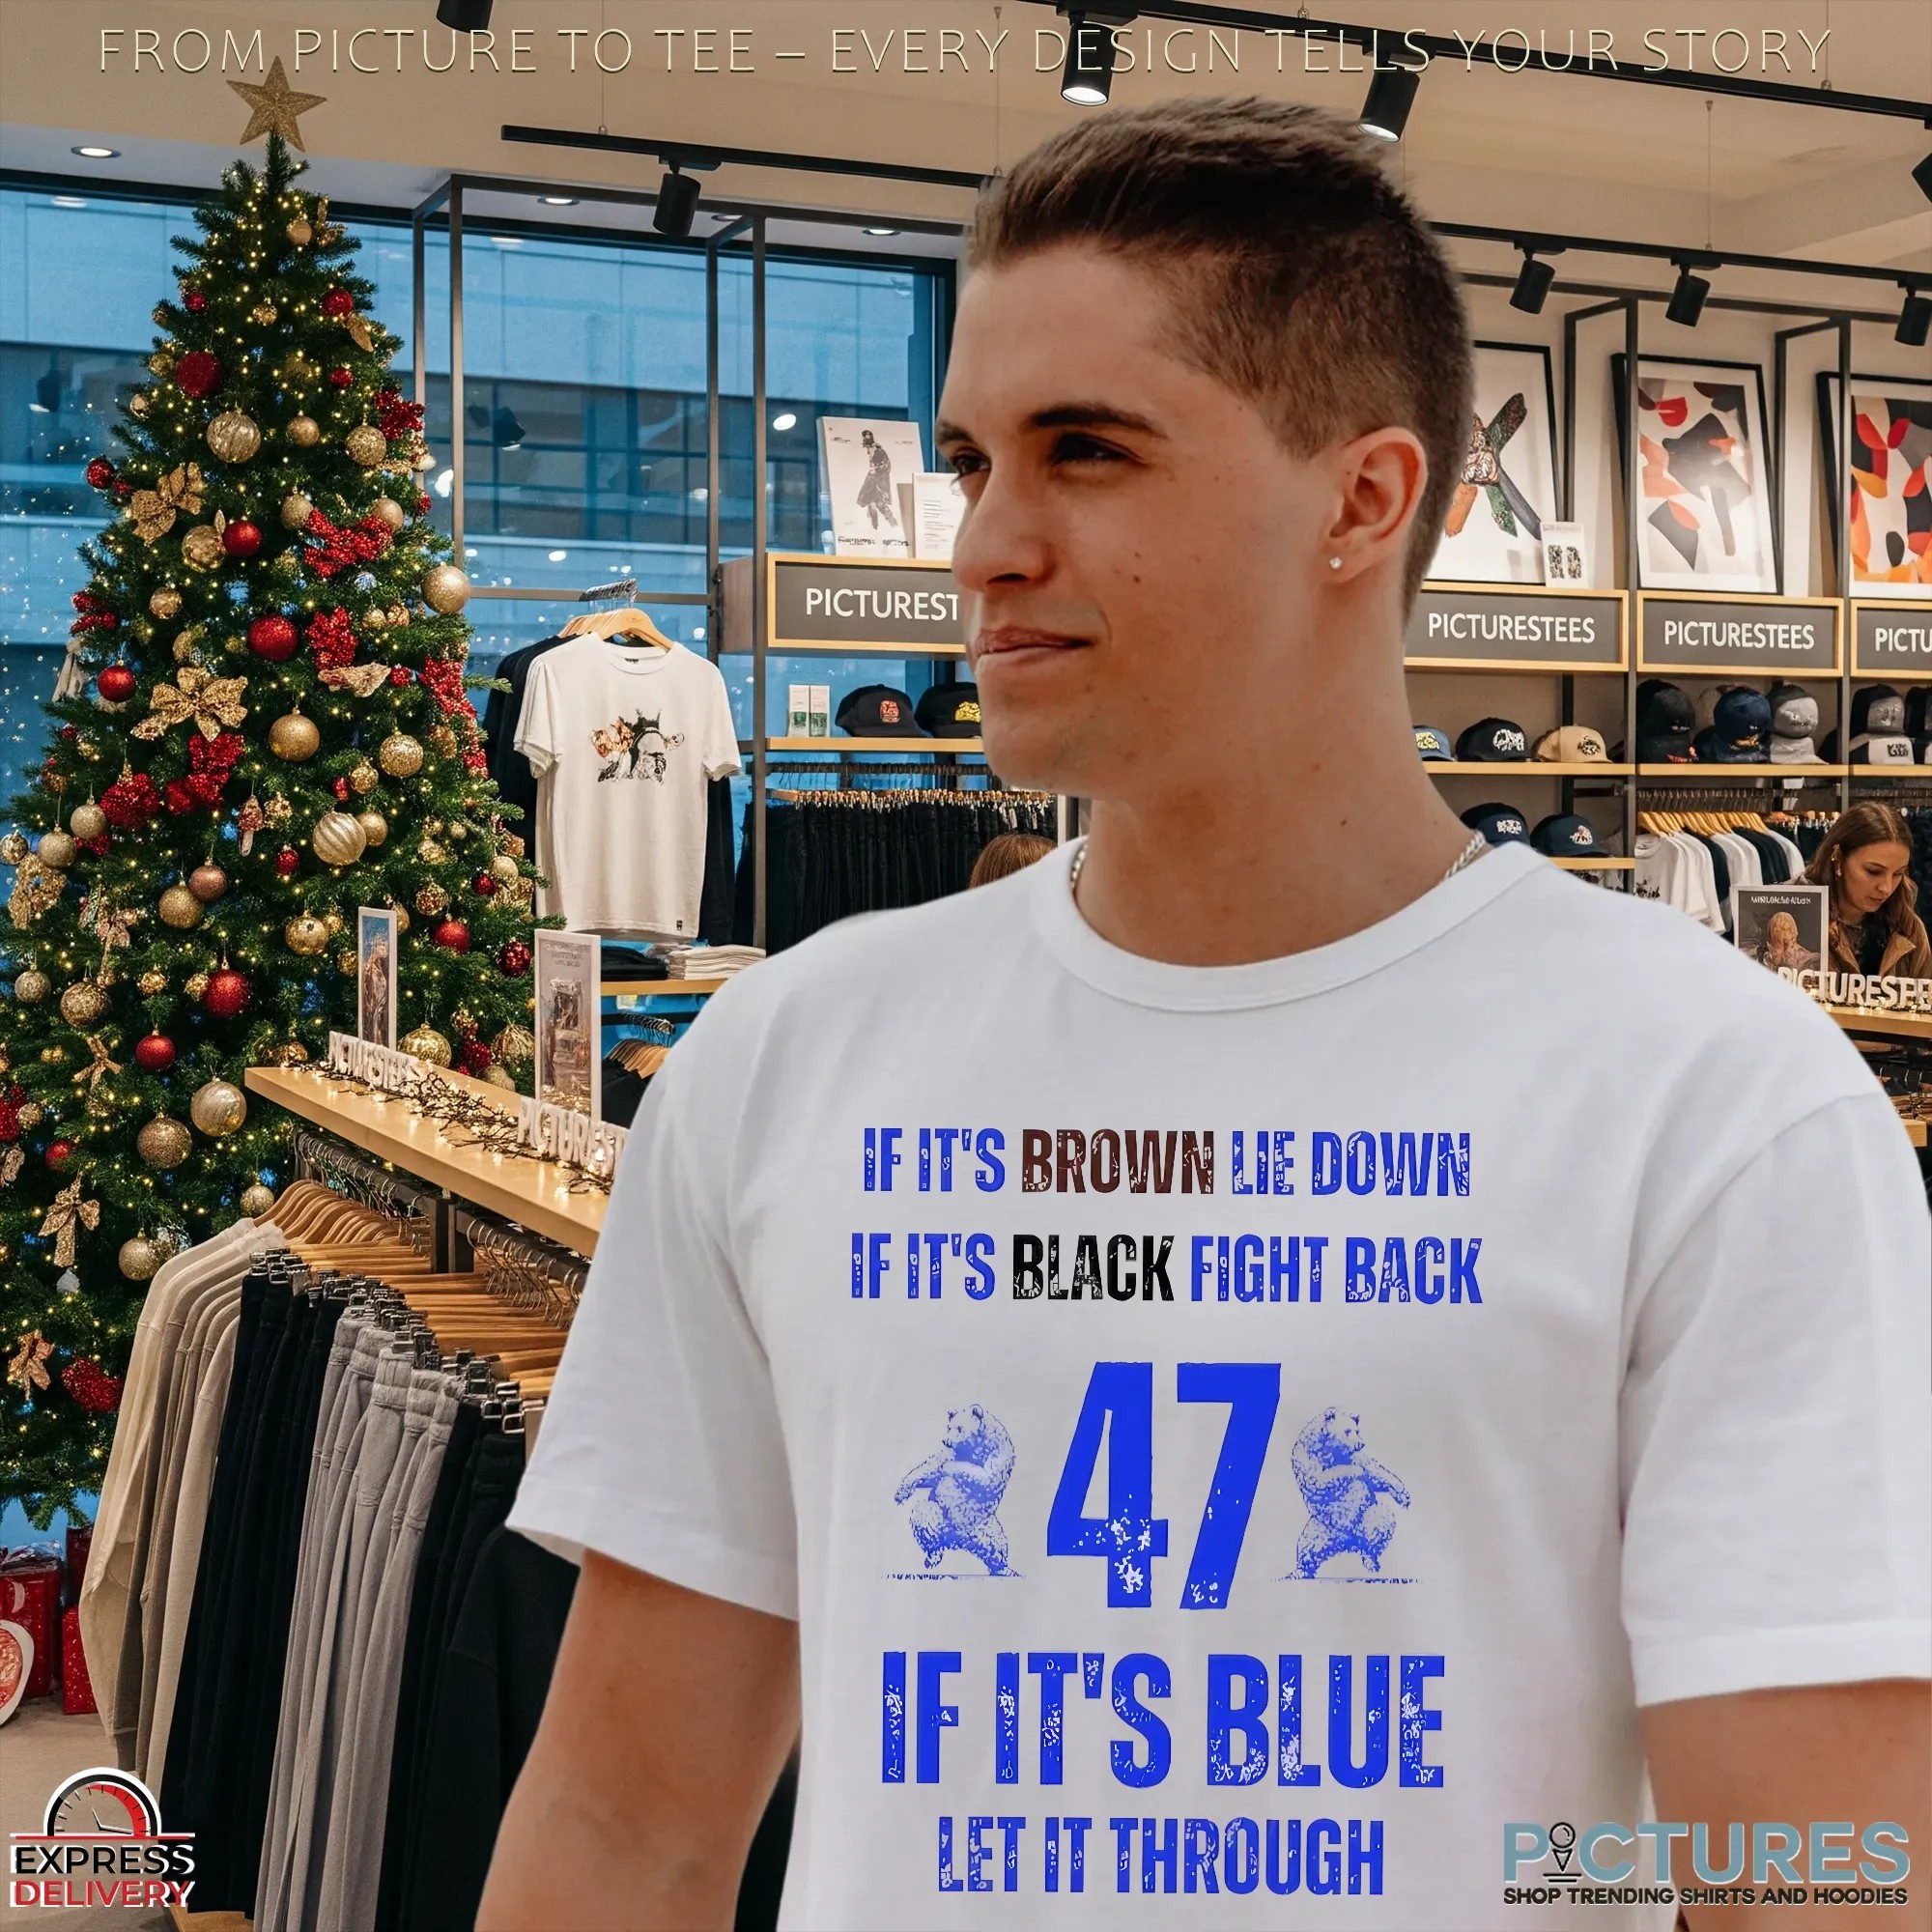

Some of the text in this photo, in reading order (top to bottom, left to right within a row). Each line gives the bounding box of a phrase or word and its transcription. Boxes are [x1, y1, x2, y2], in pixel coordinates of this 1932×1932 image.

[1428, 612, 1596, 644] PICTURESTEES
[1664, 620, 1815, 650] PICTURESTEES
[1875, 627, 1932, 653] PICTU
[863, 1127, 1471, 1198] IF IT'S BROWN LIE DOWN
[850, 1232, 1483, 1306] IF IT'S BLACK FIGHT BACK
[1047, 1361, 1282, 1610] 47
[881, 1651, 1446, 1789] IF IT'S BLUE
[938, 1816, 1384, 1896] LET IT THROUGH
